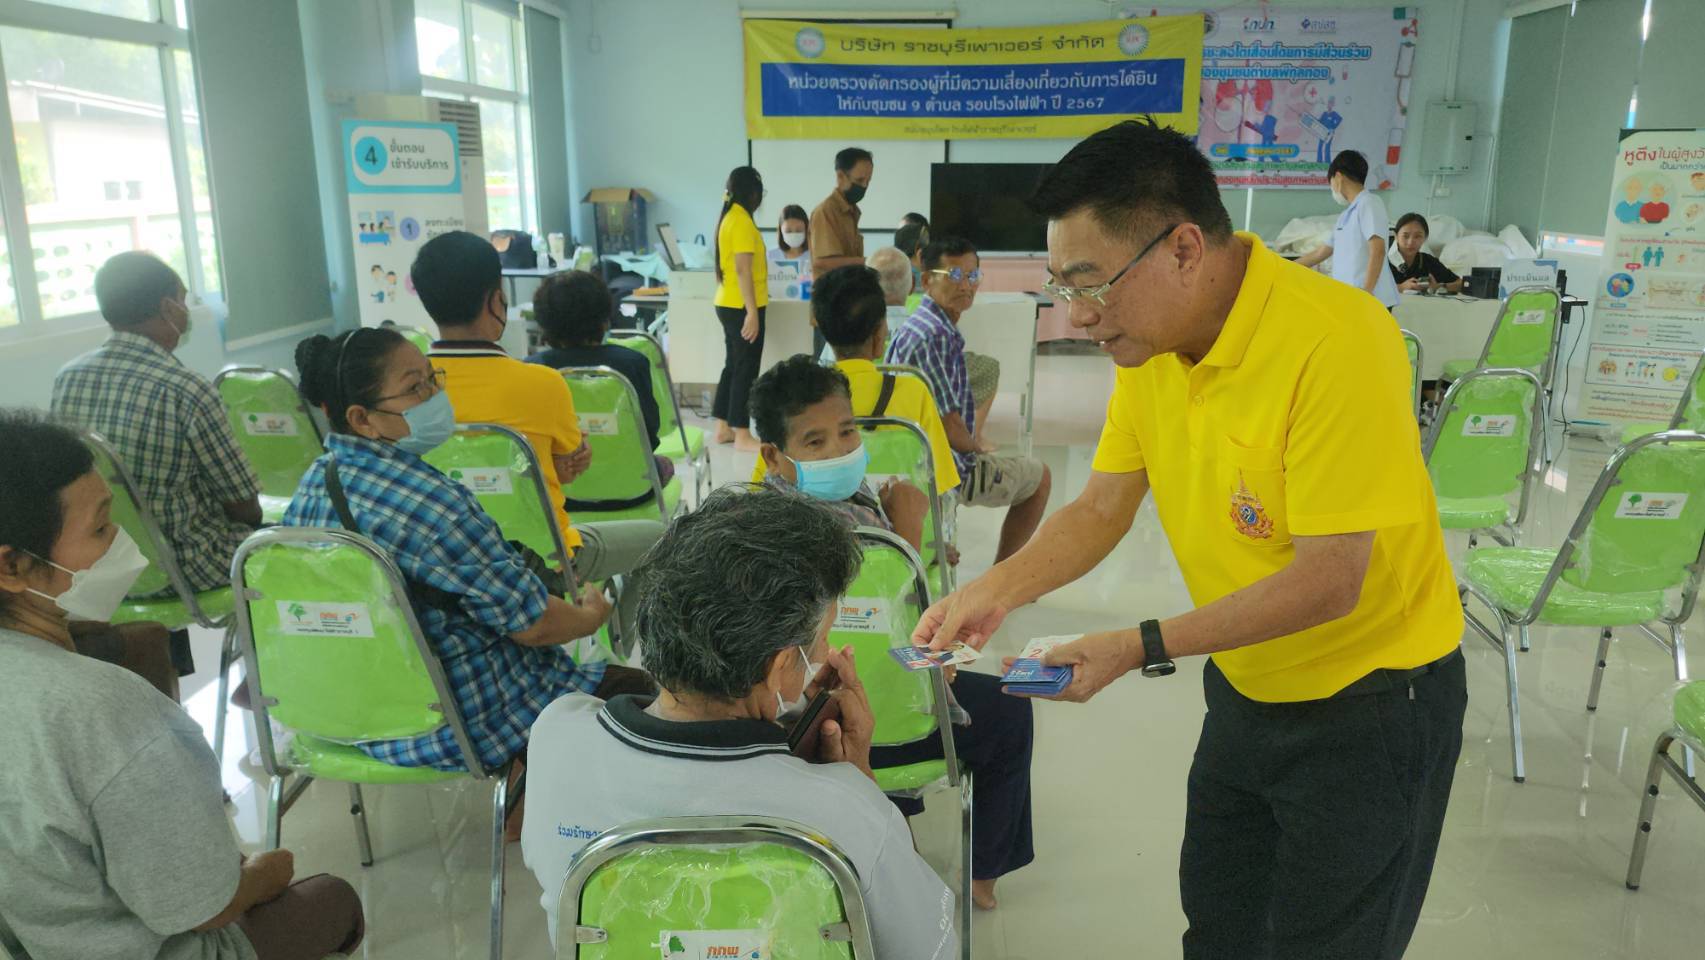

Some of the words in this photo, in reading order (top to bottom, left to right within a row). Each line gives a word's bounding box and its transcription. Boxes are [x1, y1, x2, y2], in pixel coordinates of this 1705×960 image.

[840, 37, 895, 51] บริษัท
[904, 36, 1043, 56] ราชบุรีเพาเวอร์
[1052, 35, 1105, 50] จำกัด
[837, 95, 907, 115] ให้กับชุมชน
[911, 100, 921, 112] 9
[925, 97, 962, 112] ตำบล
[966, 95, 1047, 112] รอบโรงไฟฟ้า
[1051, 94, 1062, 110] ปี
[1066, 97, 1105, 109] 2567
[364, 146, 378, 166] 4
[389, 138, 425, 154] ขั้นตอน
[391, 158, 449, 171] เข้ารับบริการ
